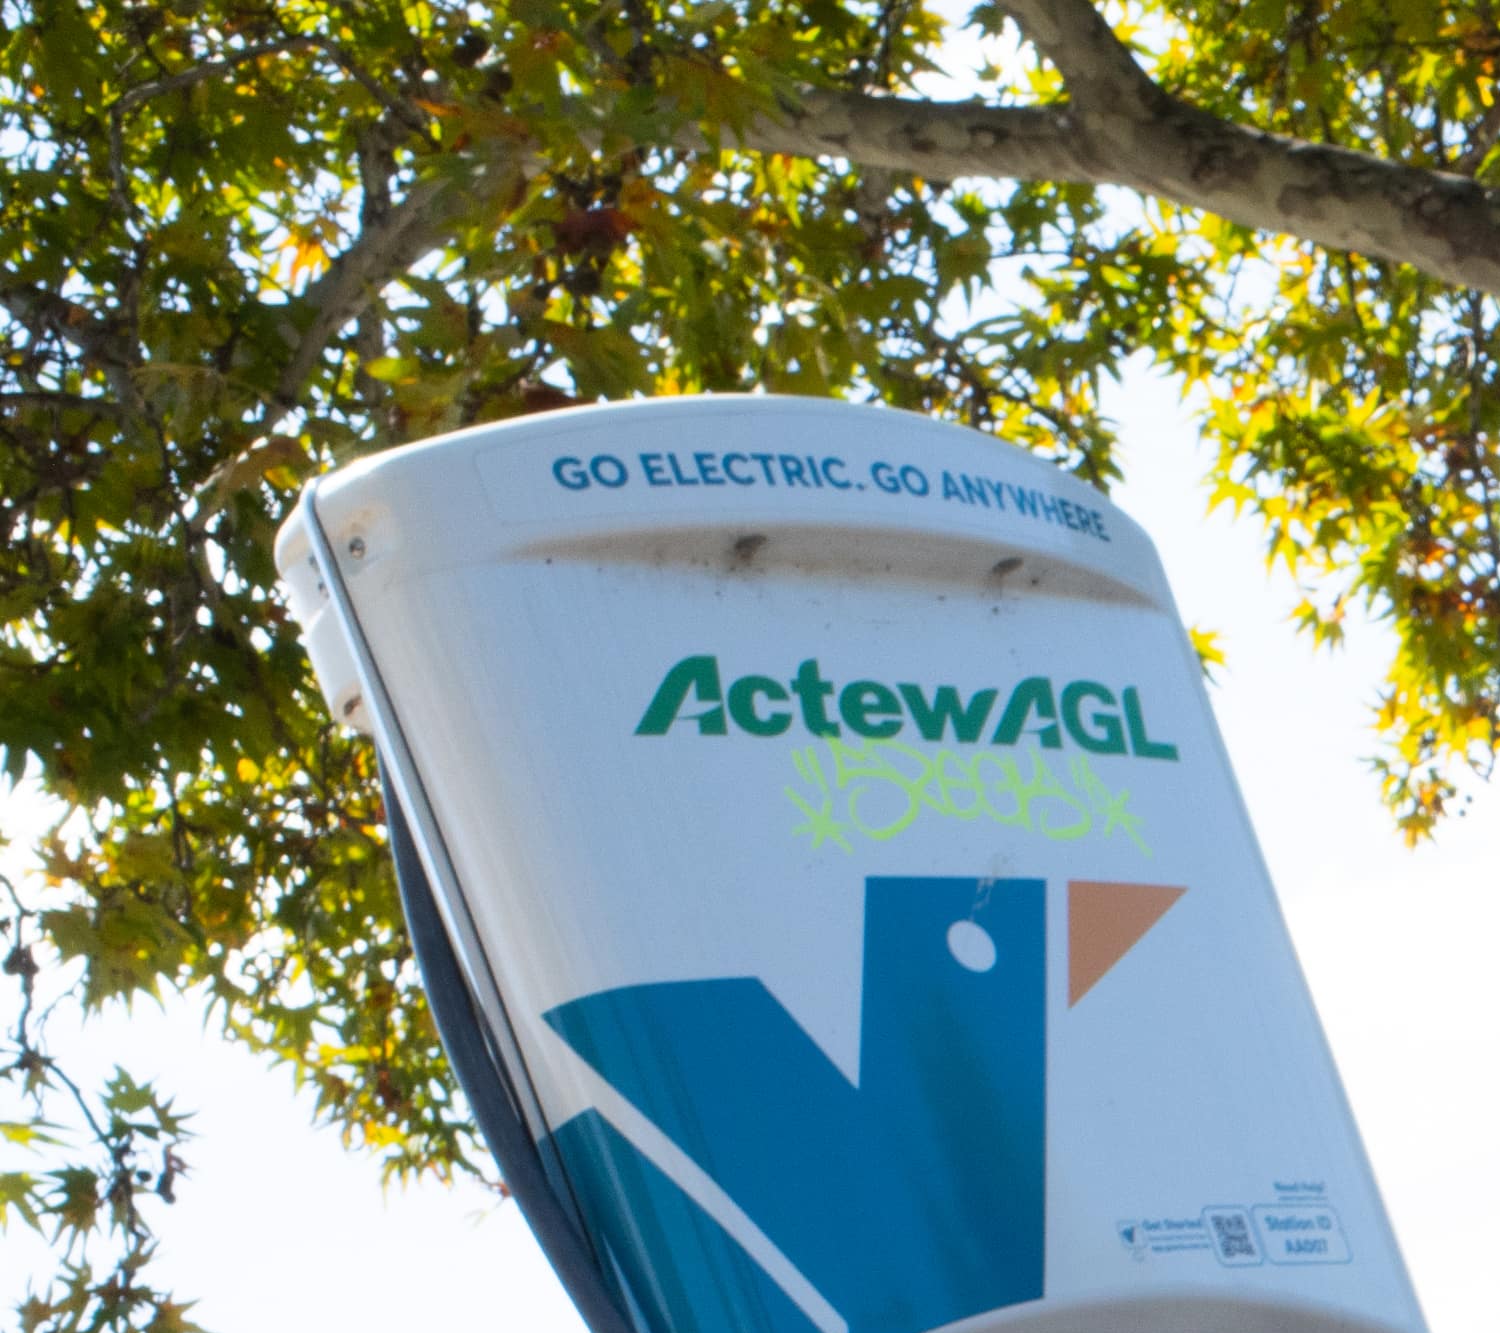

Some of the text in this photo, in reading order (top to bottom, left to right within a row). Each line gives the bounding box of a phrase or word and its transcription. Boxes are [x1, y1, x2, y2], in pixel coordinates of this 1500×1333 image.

[551, 452, 1111, 543] GO ELECTRIC. GO ANYWHERE
[633, 655, 1179, 763] ActewAGL
